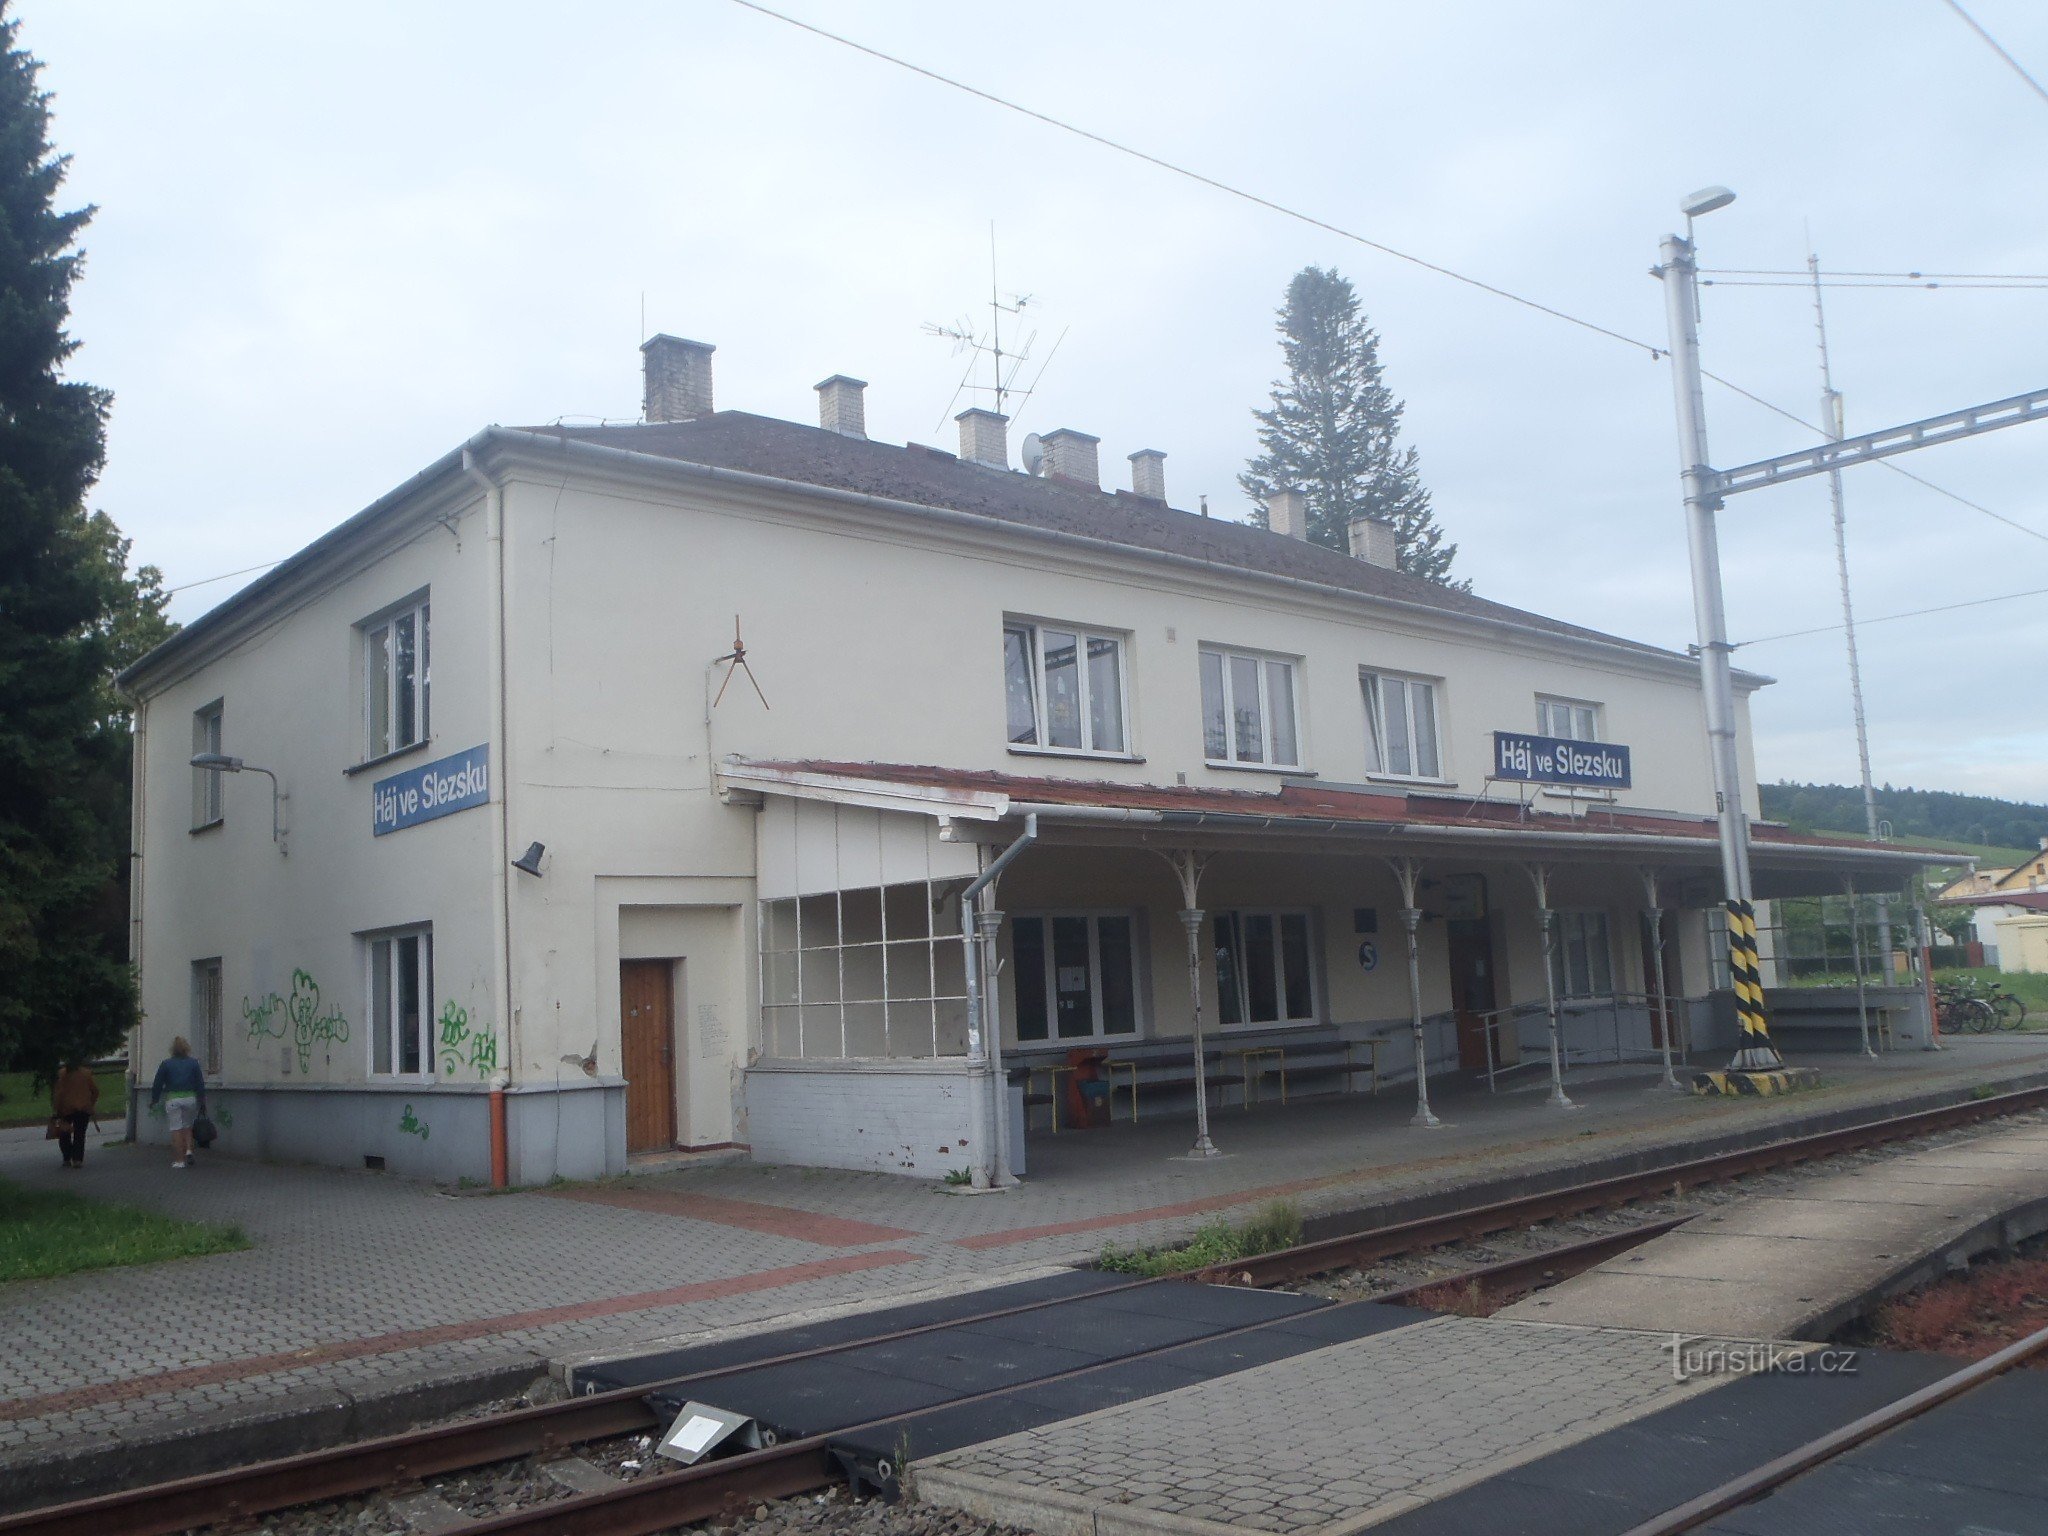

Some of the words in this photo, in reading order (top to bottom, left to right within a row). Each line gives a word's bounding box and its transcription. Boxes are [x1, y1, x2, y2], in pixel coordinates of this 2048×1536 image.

[1501, 740, 1531, 779] Háj
[1535, 754, 1552, 773] ve
[1556, 745, 1623, 779] Slezsku
[374, 786, 397, 826] Háj
[399, 787, 418, 816] ve
[422, 760, 487, 809] Slezsku
